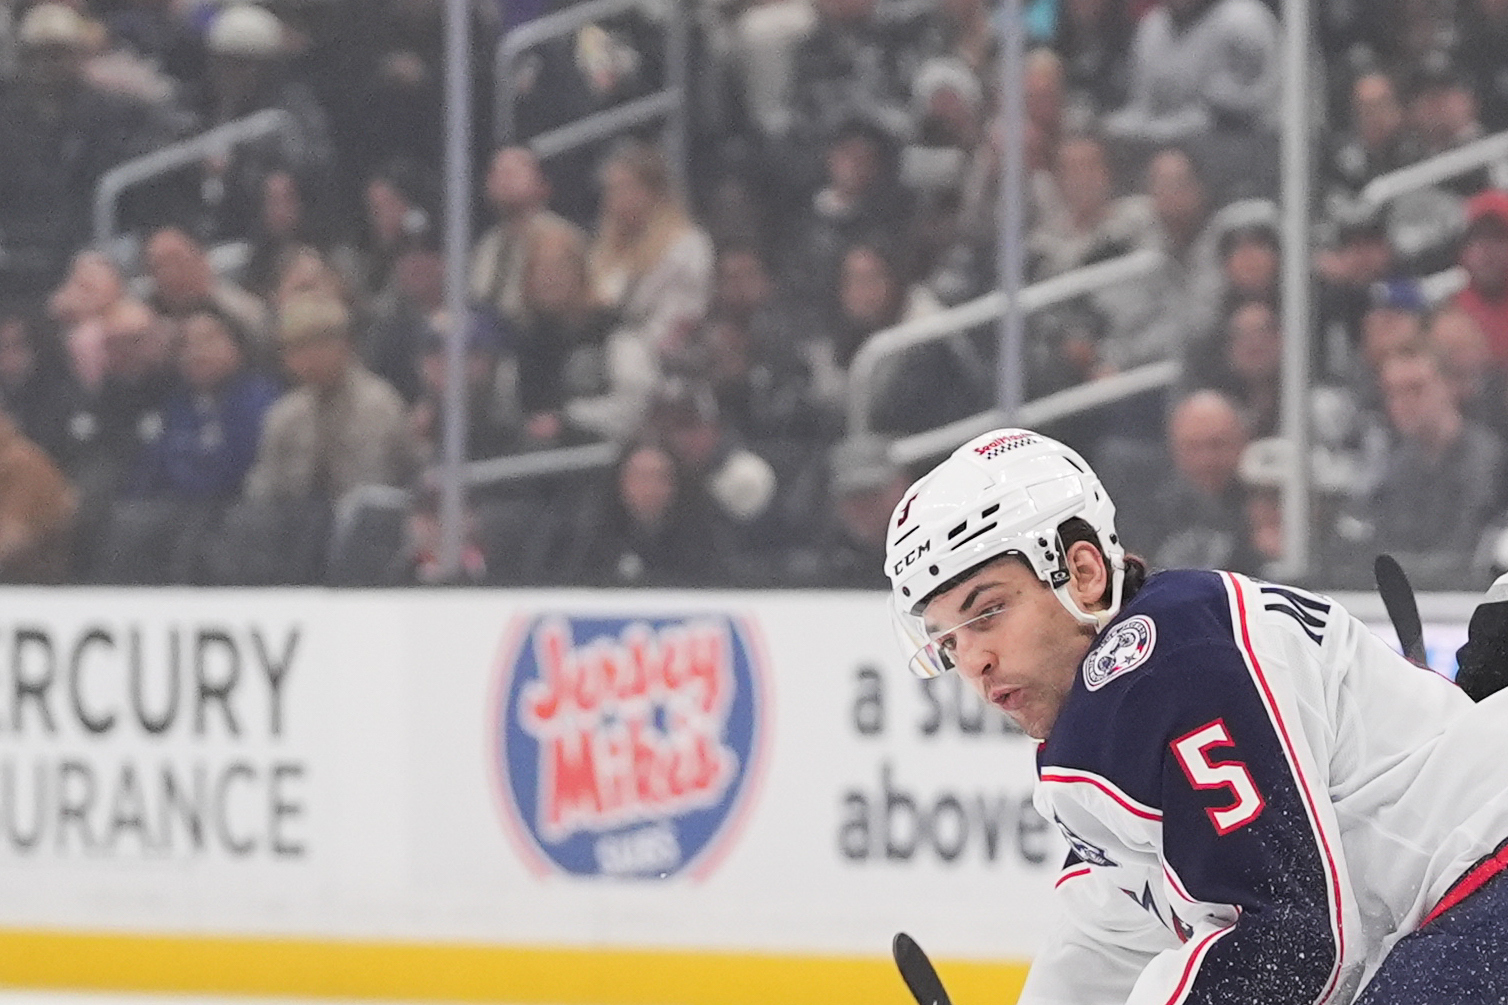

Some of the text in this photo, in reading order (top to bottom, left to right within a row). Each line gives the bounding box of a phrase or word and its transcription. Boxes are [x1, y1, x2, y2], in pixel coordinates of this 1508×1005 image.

[893, 538, 930, 577] CCM
[0, 625, 302, 738] RCURY
[531, 625, 723, 720] Jersey
[852, 664, 1024, 735] a su
[0, 756, 306, 857] URANCE
[838, 758, 1052, 865] above
[1170, 717, 1266, 836] 5
